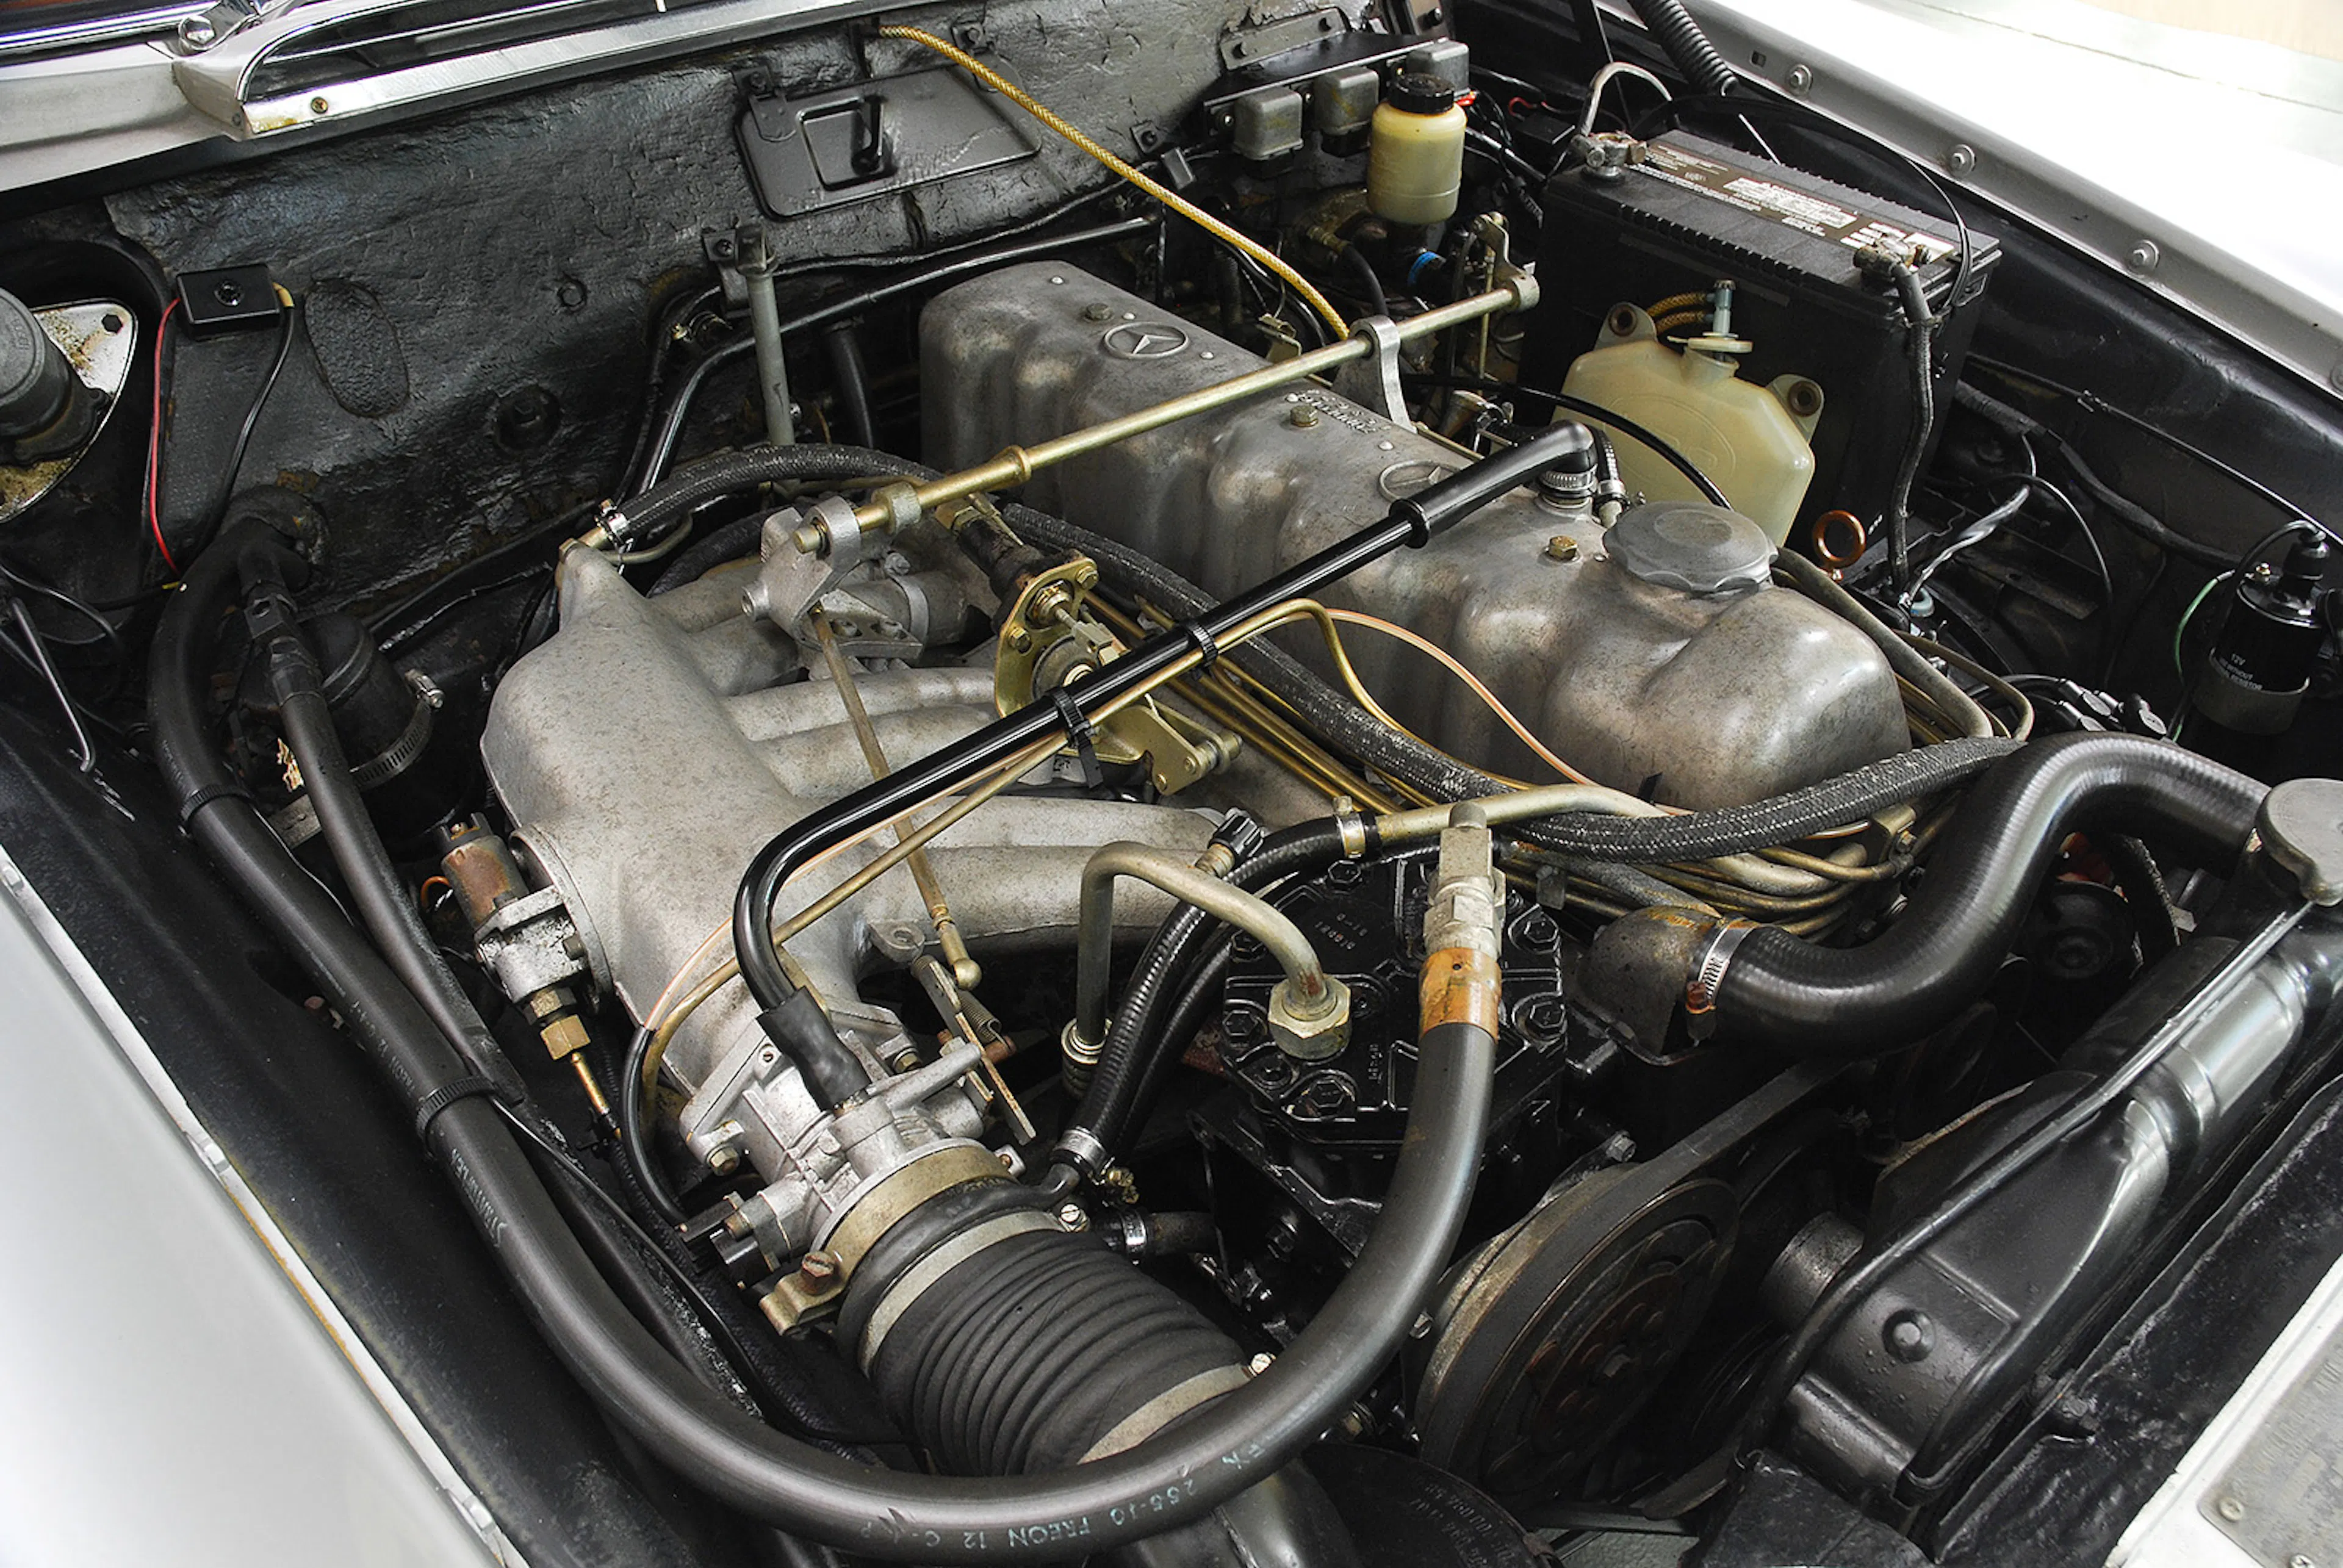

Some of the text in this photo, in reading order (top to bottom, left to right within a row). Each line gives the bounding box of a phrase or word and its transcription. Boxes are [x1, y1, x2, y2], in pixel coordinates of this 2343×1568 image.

[1109, 1478, 1199, 1526] 255-10
[963, 1531, 987, 1550] 12
[1007, 1516, 1092, 1547] FREON
